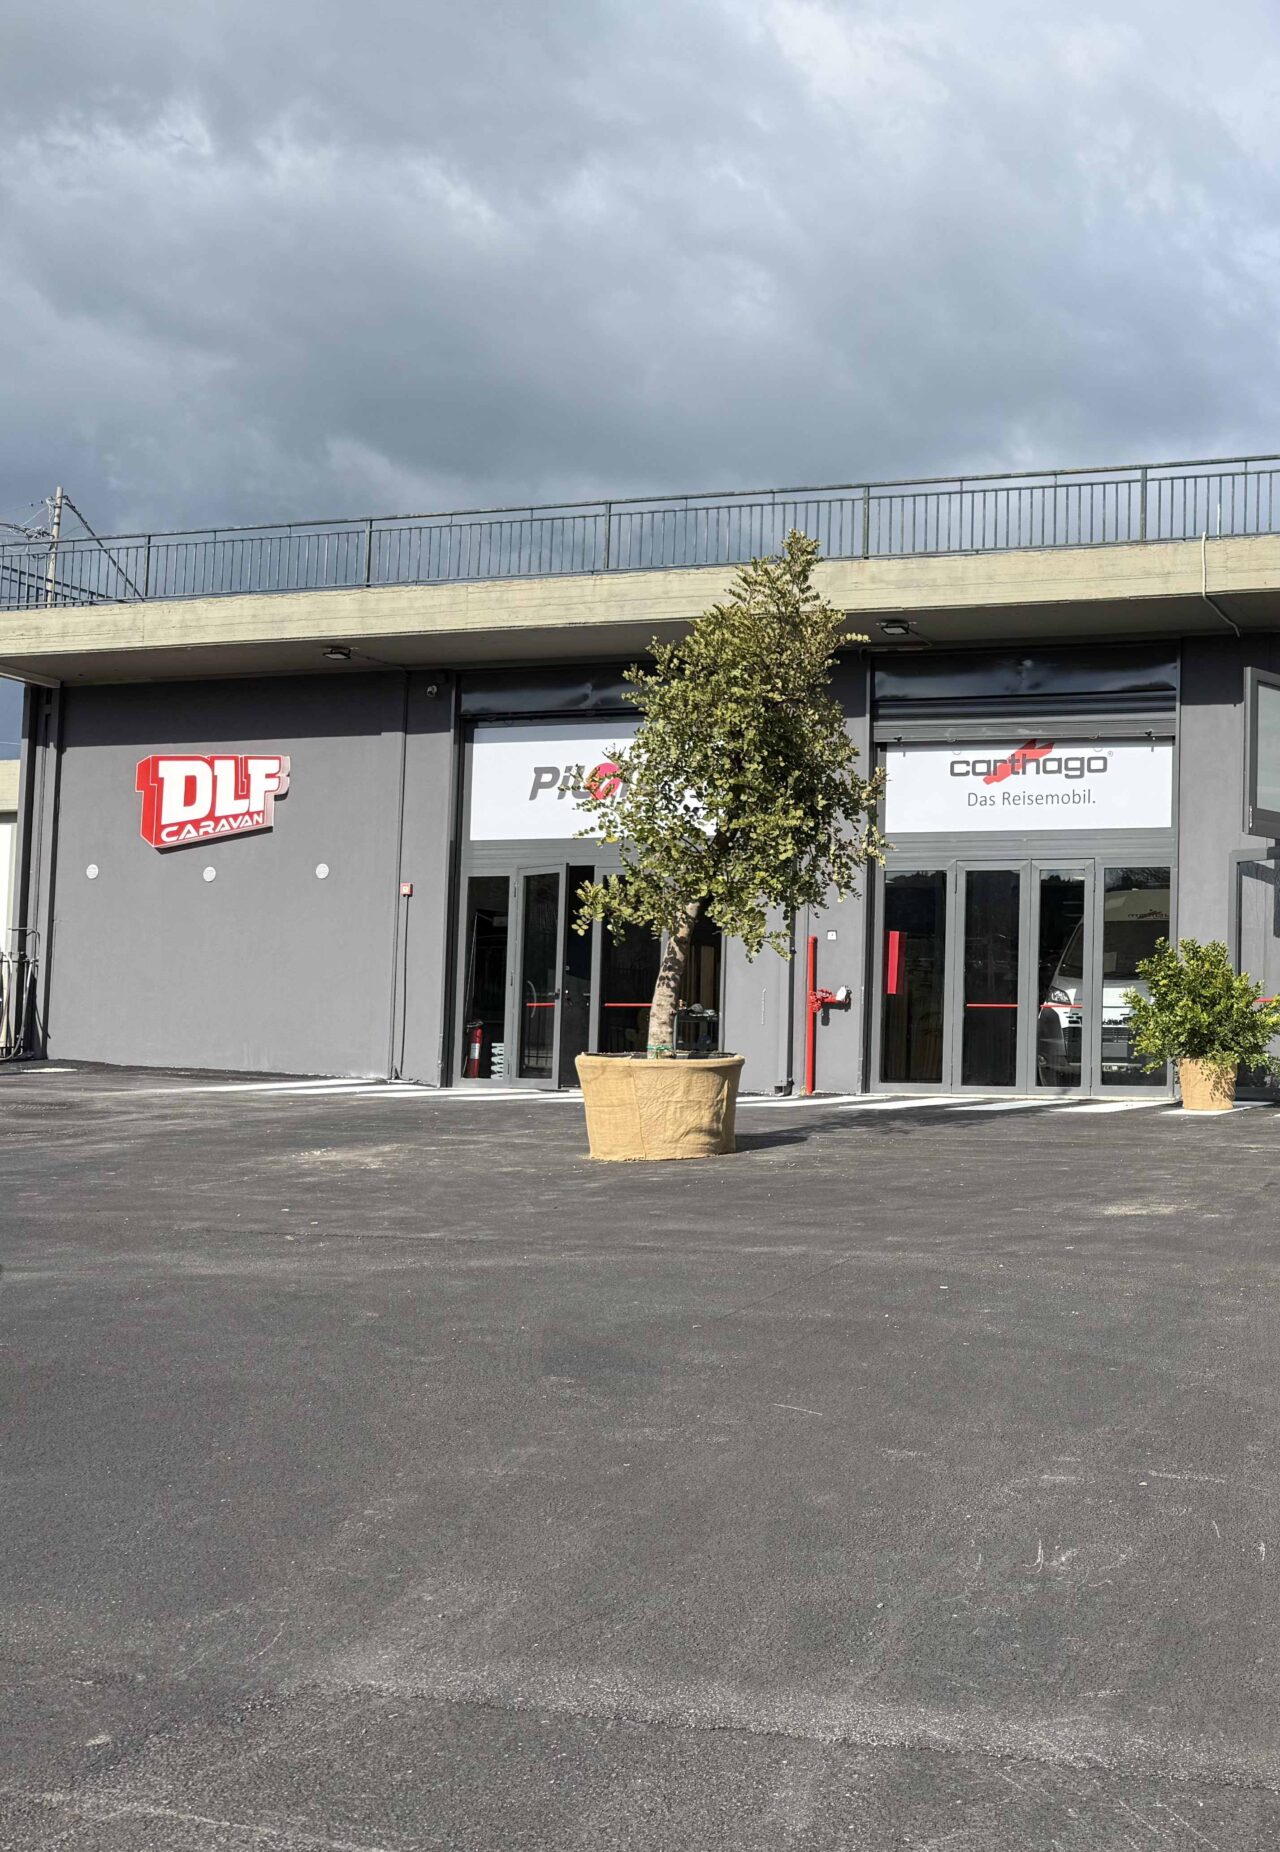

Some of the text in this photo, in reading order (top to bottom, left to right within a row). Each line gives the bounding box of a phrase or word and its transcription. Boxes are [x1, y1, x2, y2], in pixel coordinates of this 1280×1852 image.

[950, 754, 1109, 779] carthago
[158, 759, 280, 825] DLF
[967, 789, 1096, 807] Das Reisemobil.
[160, 812, 264, 842] CARAVAN
